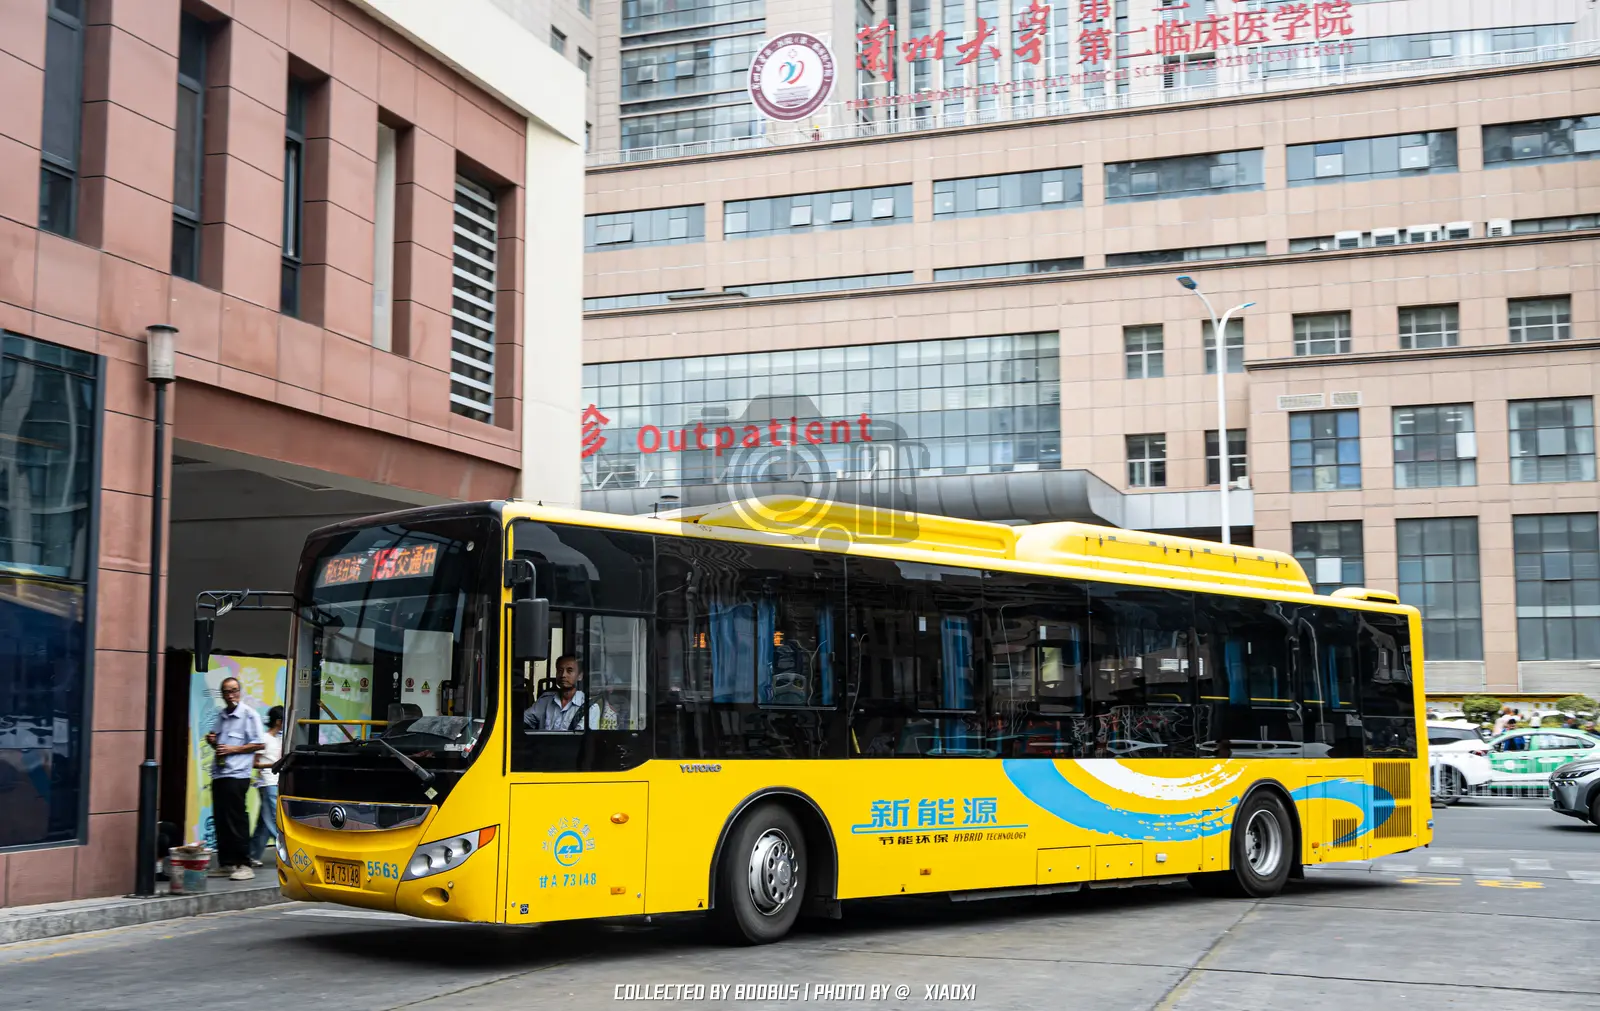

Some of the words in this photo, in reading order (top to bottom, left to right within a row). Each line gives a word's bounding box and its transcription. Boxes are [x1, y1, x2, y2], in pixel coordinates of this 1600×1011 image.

[1076, 0, 1354, 65] 第二临床医学院
[636, 412, 873, 457] Outpatient
[679, 763, 722, 774] YUTONG
[870, 797, 998, 828] 新能源
[878, 834, 949, 846] 节能环保
[953, 832, 984, 843] HYBRID
[986, 832, 1027, 842] TECHNOLOGY
[293, 853, 309, 867] CNG
[367, 860, 399, 880] 5563
